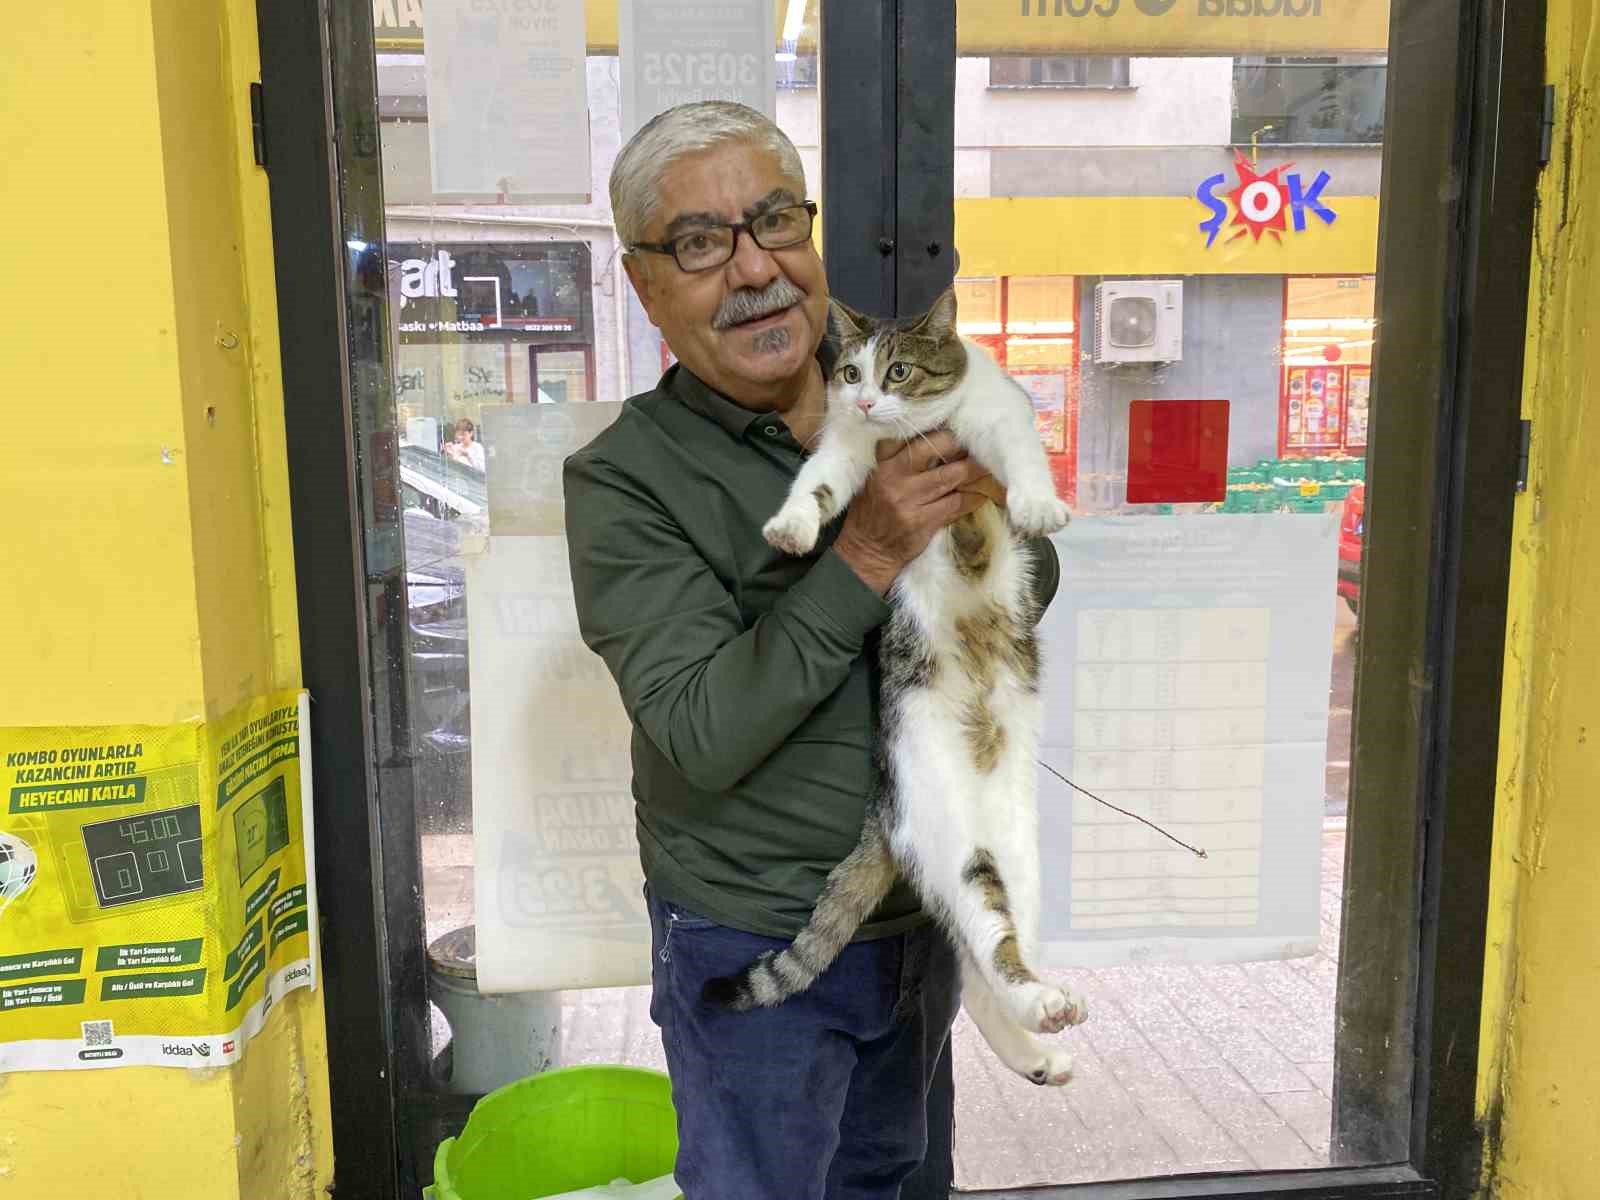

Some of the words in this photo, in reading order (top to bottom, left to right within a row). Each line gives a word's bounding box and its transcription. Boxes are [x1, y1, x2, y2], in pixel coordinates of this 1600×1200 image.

[1197, 170, 1337, 249] ŞOK
[438, 321, 484, 332] Matbaa
[7, 749, 57, 767] KOMBO
[60, 743, 143, 763] OYUNLARLA
[16, 765, 91, 784] KAZANCINI
[94, 761, 136, 777] ARTIR
[19, 788, 89, 807] HEYECANI
[92, 783, 136, 801] KATLA
[162, 1043, 193, 1056] iddaa
